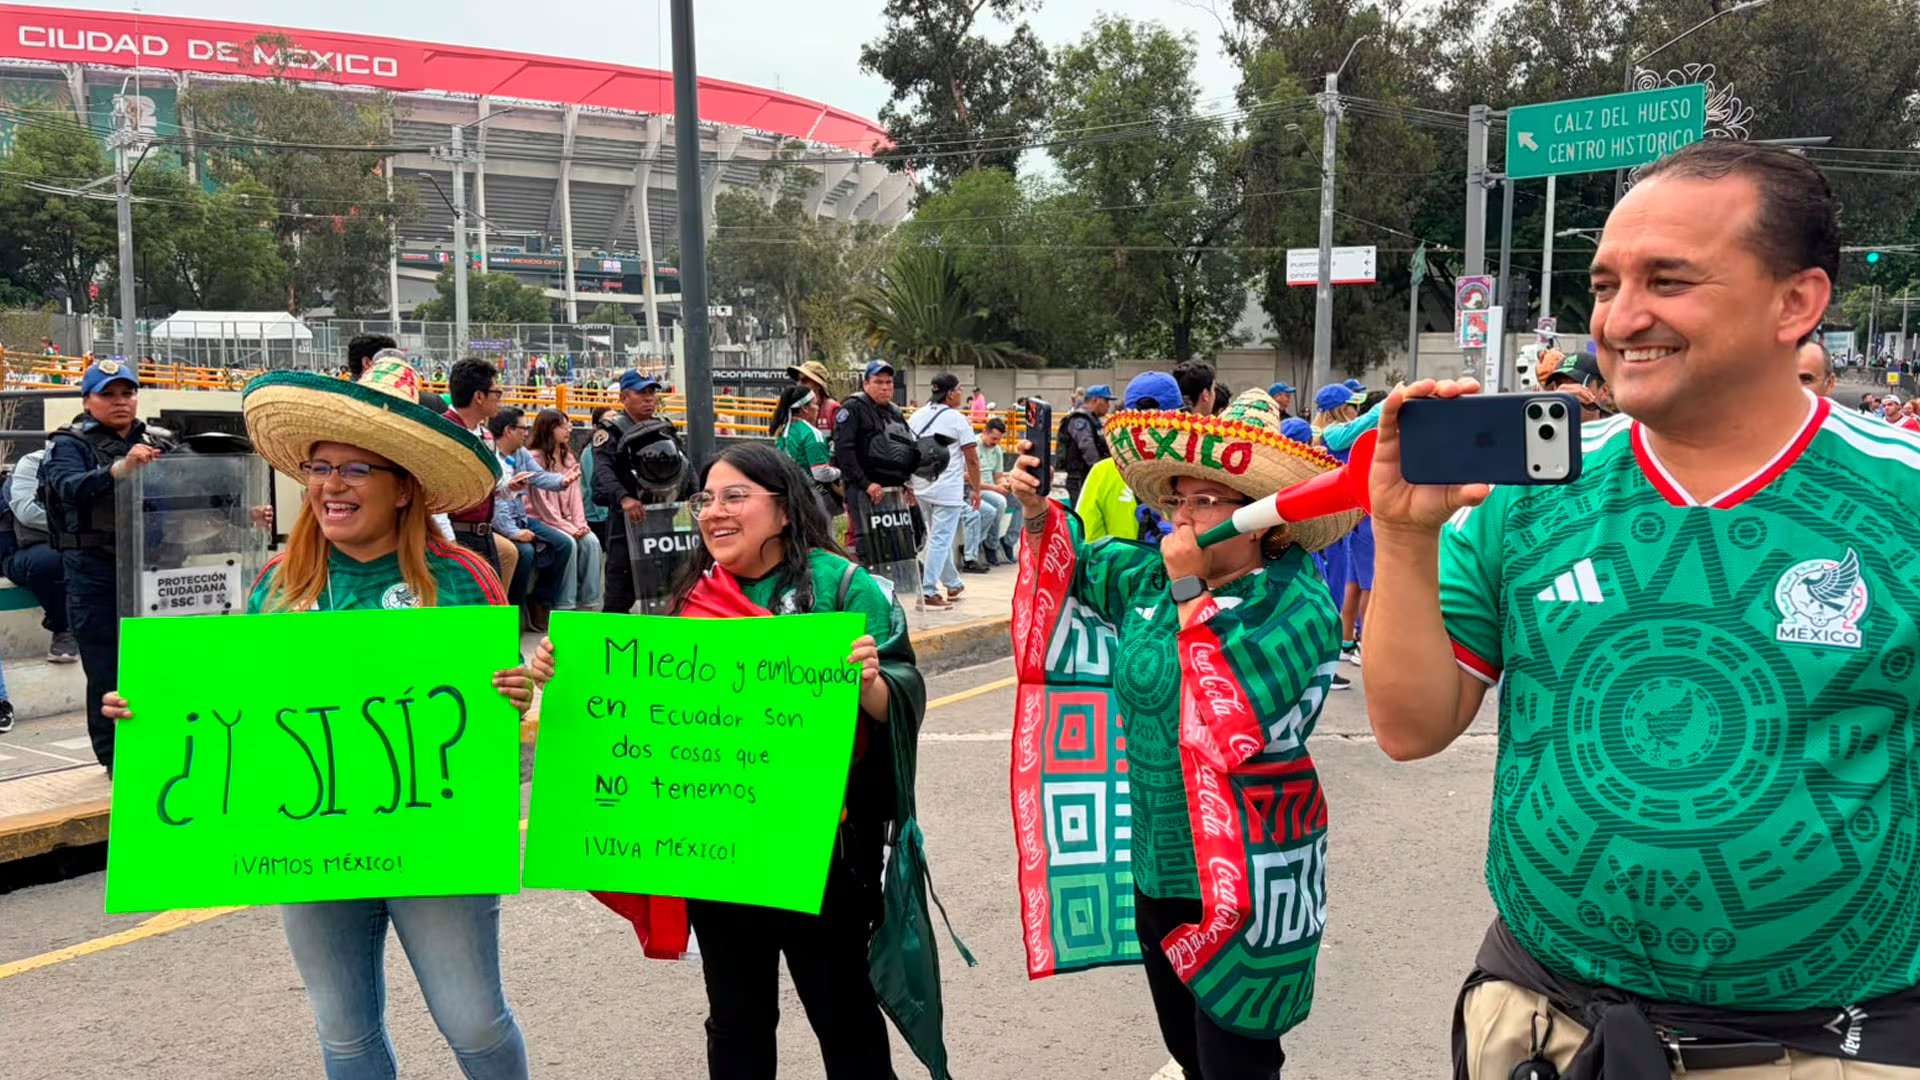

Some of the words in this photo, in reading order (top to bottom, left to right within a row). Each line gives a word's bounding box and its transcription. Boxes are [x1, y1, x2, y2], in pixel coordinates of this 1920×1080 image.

[18, 25, 169, 55] CIUDAD
[188, 39, 239, 62] DE
[1554, 110, 1594, 134] CALZ
[1601, 105, 1628, 129] DEL
[1638, 98, 1691, 124] HUESO
[1549, 138, 1605, 164] CENTRO
[1611, 129, 1693, 158] HISTORICO
[1110, 425, 1252, 475] MEXICO
[157, 571, 227, 587] PROTECCIÓN
[157, 582, 227, 598] CIUDADANA
[170, 596, 195, 608] SSC
[1780, 625, 1858, 644] MÉXICO
[605, 637, 716, 683] Miedo
[732, 660, 745, 693] y
[756, 655, 858, 698] embajada
[586, 695, 627, 719] en
[650, 704, 744, 727] Ecuador
[157, 709, 242, 826] ¿Y
[275, 705, 348, 820] SI
[611, 734, 652, 759] dos
[670, 744, 721, 763] cosas
[736, 749, 770, 768] que
[595, 774, 629, 796] NO
[650, 776, 756, 804] tenemos
[585, 828, 641, 859] ¡VIVA
[656, 838, 736, 863] MÉXICO!
[233, 853, 313, 876] ¡VAMOS
[324, 852, 403, 874] MÉXICO!
